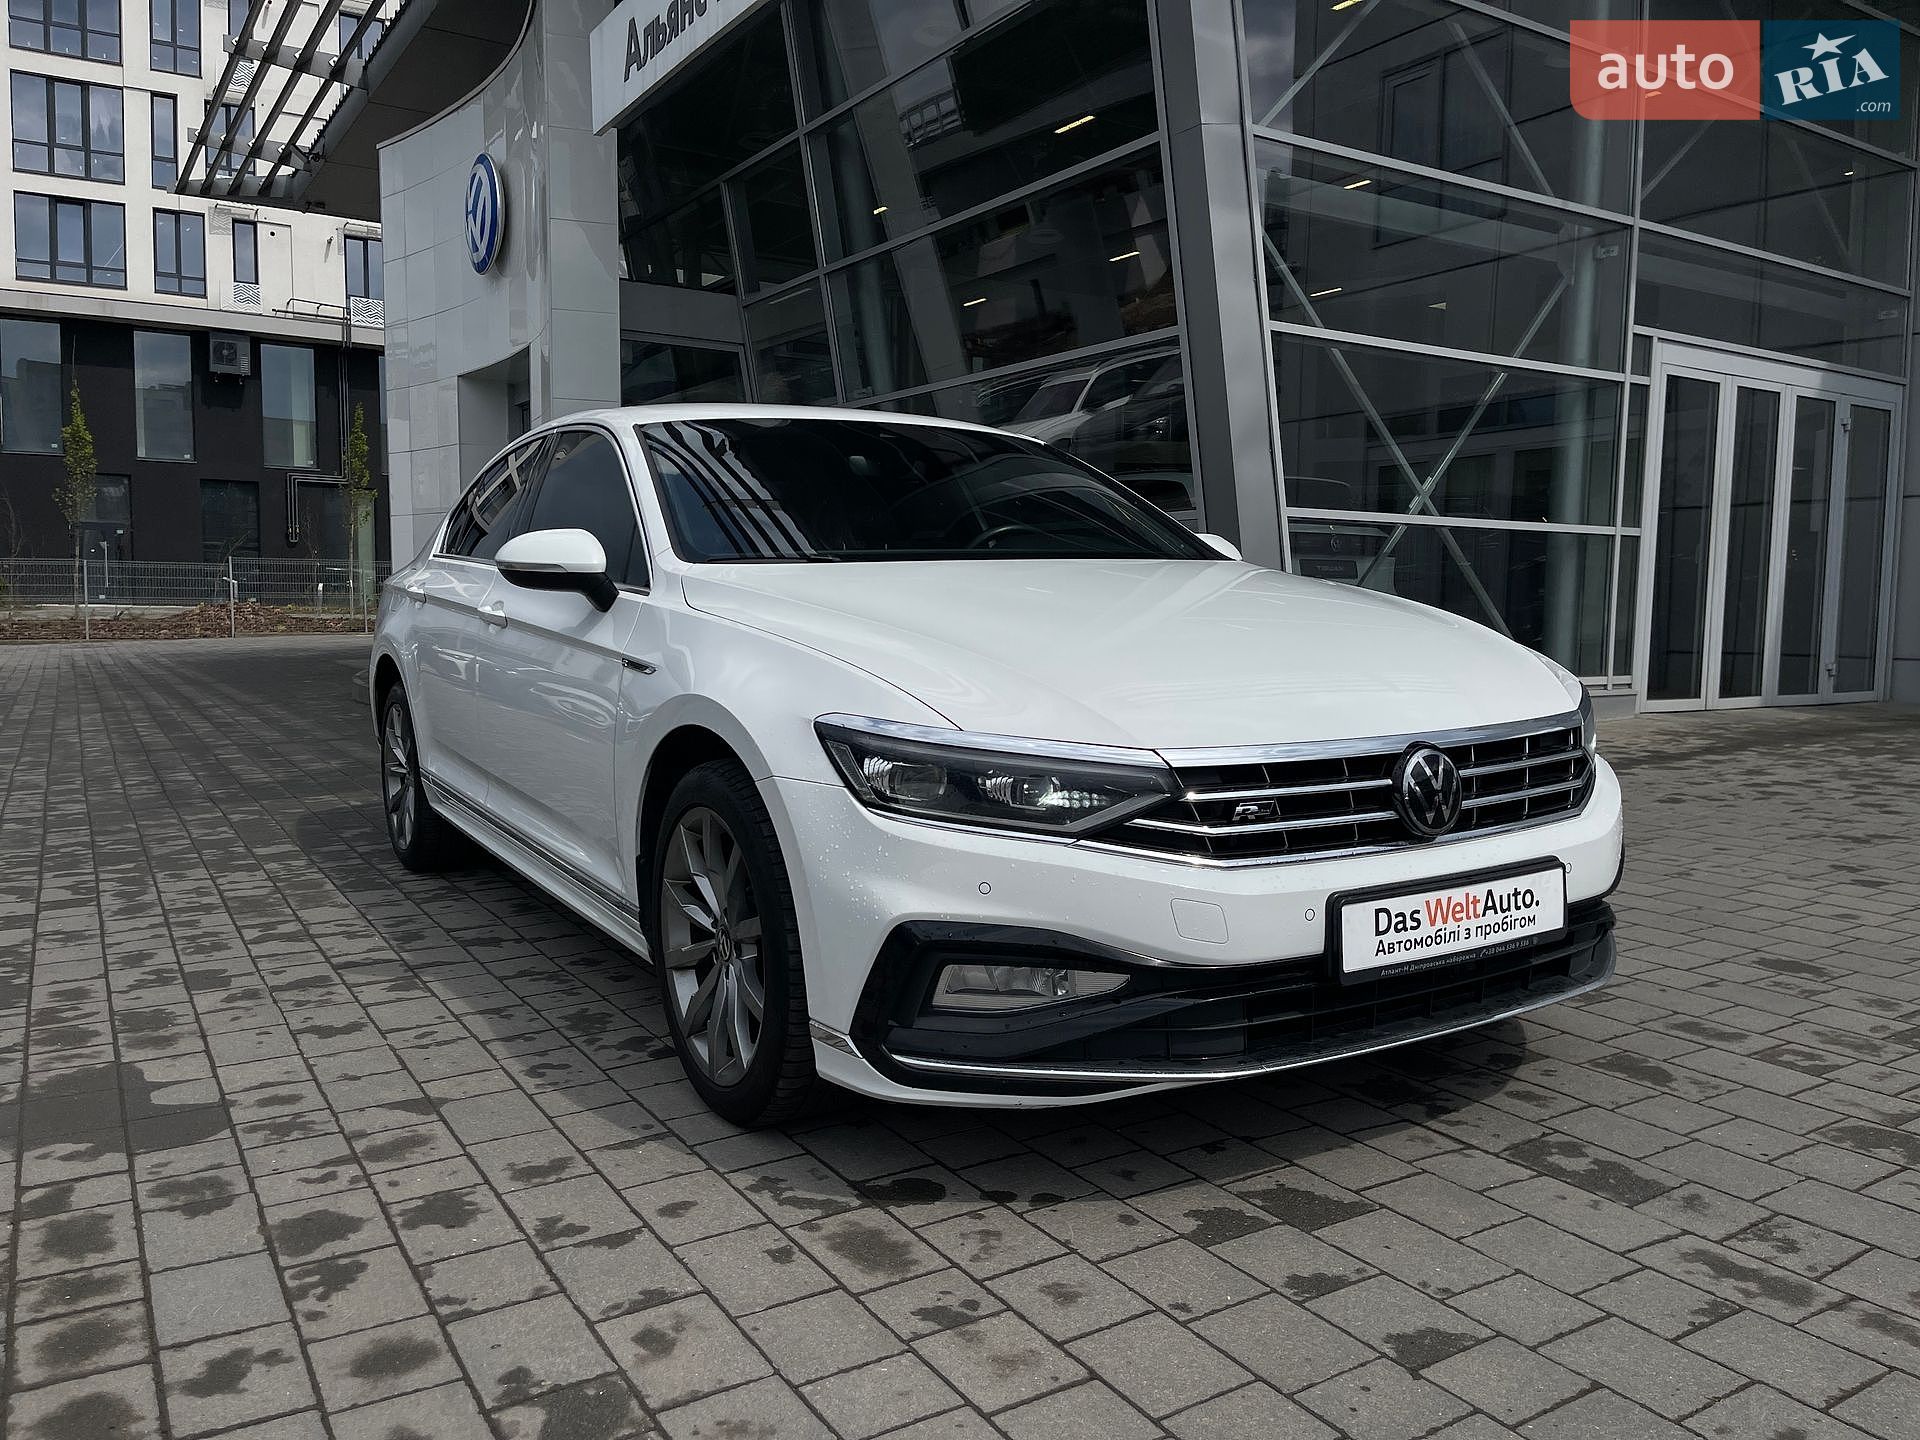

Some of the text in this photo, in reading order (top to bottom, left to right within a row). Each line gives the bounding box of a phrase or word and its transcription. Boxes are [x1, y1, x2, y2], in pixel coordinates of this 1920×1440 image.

[1374, 907, 1422, 937] Das
[1374, 914, 1536, 957] Автомобілі з пробігом
